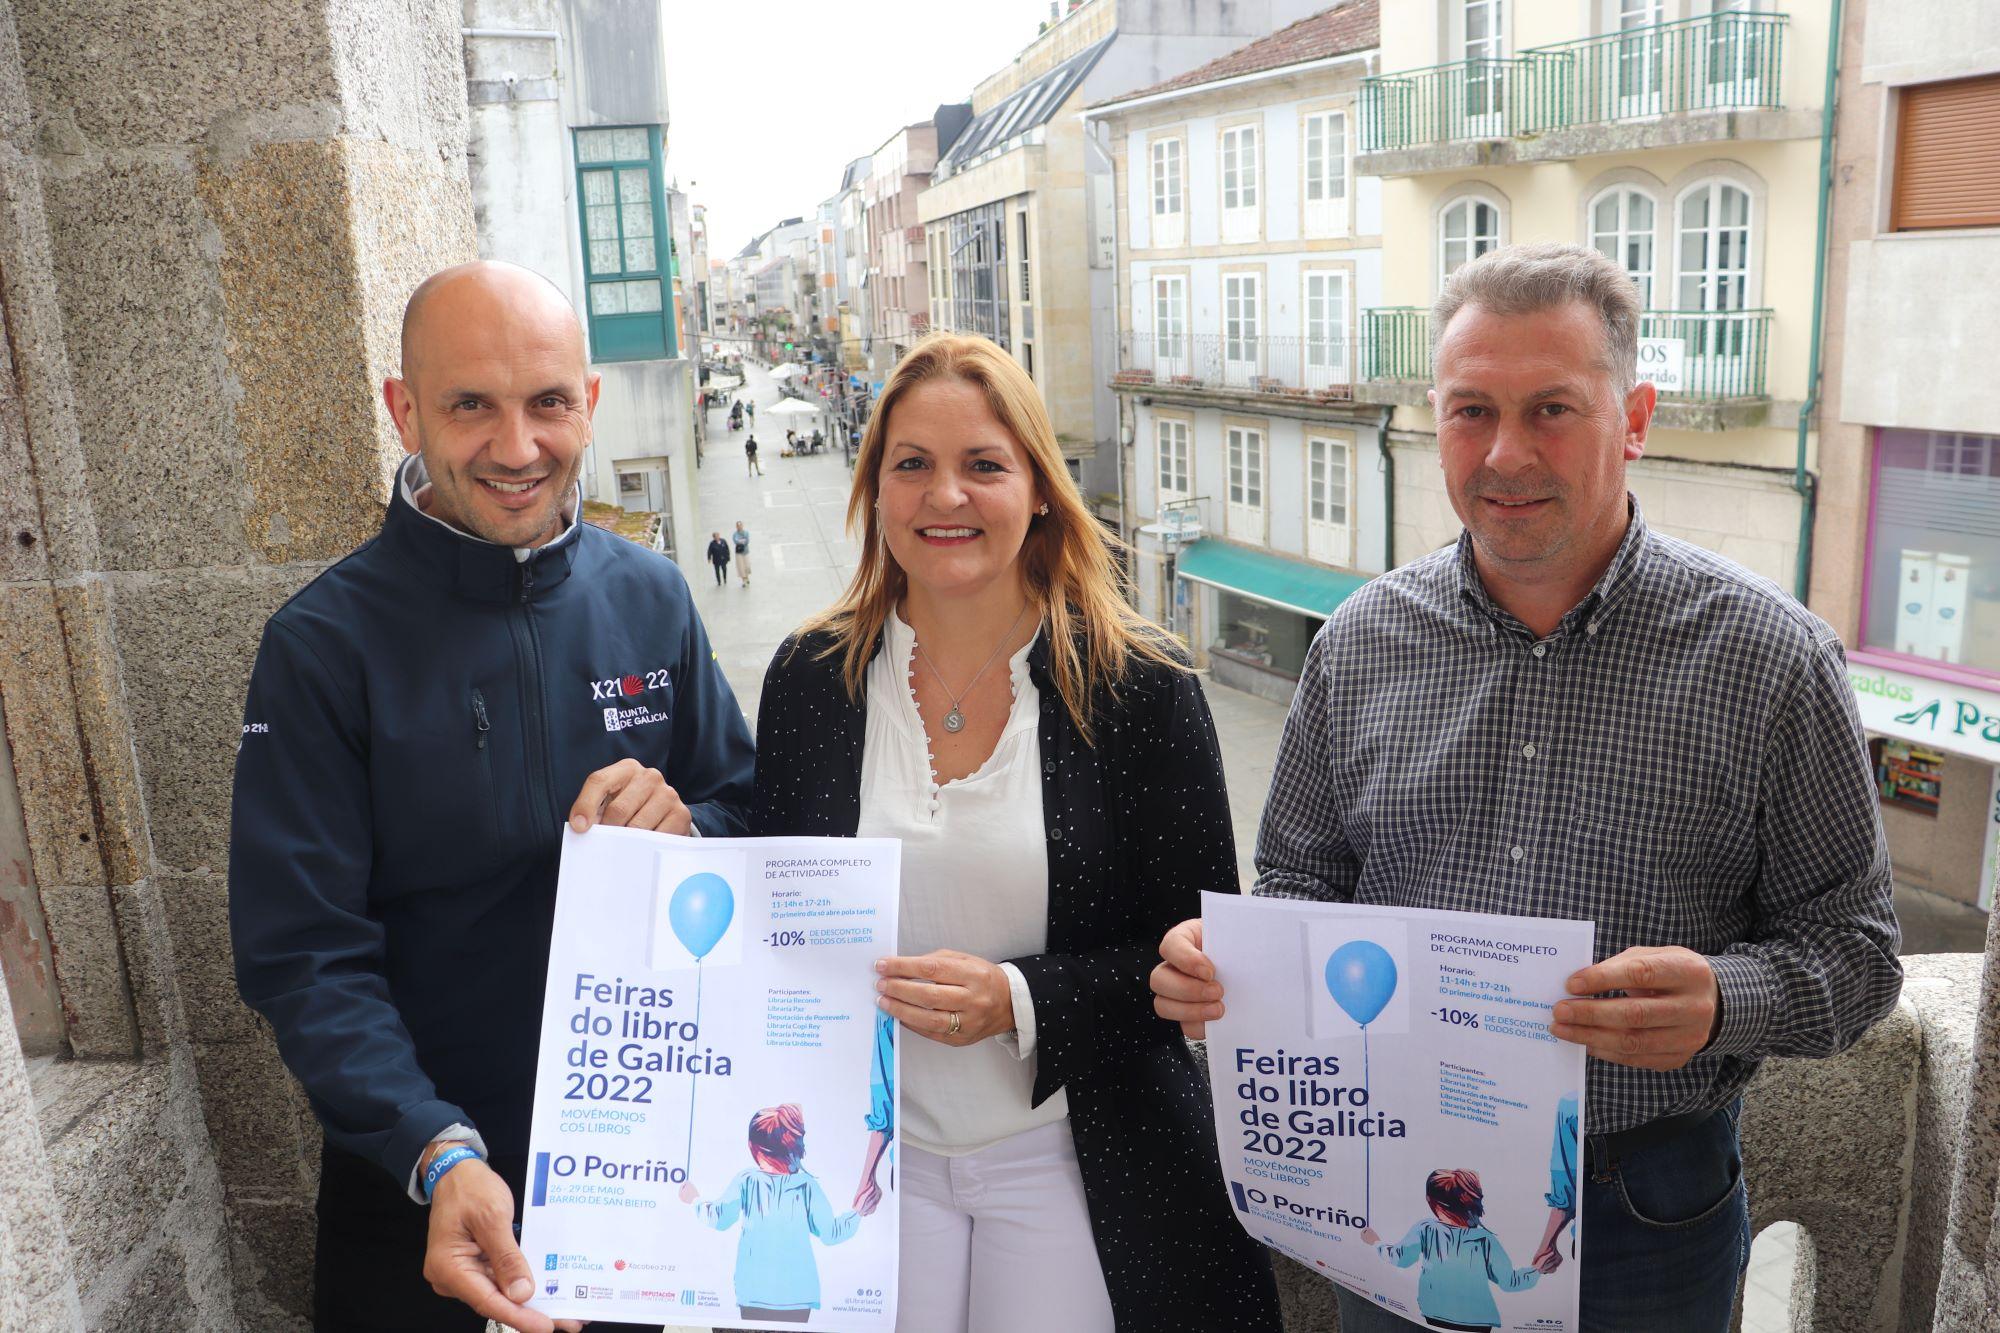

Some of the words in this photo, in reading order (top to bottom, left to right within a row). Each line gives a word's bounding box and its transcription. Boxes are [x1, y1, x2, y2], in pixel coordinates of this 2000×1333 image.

[1637, 345, 1667, 363] OS
[1637, 368, 1677, 384] orido
[590, 677, 623, 700] X21
[645, 669, 669, 690] 22
[619, 706, 649, 719] XUNTA
[620, 720, 633, 729] DE
[634, 712, 668, 725] GALICIA
[948, 715, 959, 728] S
[765, 859, 818, 868] PROGRAMA
[820, 858, 872, 867] COMPLETO
[765, 871, 777, 879] DE
[779, 869, 839, 879] ACTIVIDADES
[772, 890, 802, 898] Horario:
[772, 900, 798, 908] 11-14h
[805, 899, 831, 907] 17-21h
[771, 911, 779, 919] (O
[780, 910, 806, 919] primeiro
[842, 908, 855, 917] pola
[856, 908, 876, 916] tarde)
[763, 931, 806, 947] -10%
[820, 928, 861, 936] DESCONTO
[847, 936, 873, 944] LIBROS
[1430, 933, 1494, 949] PROGRAMA
[1495, 941, 1558, 956] COMPLETO
[1430, 943, 1445, 953] DE
[1447, 945, 1519, 963] ACTIVIDADES
[1440, 964, 1476, 977] Horario:
[574, 973, 674, 1008] Feiras
[1440, 975, 1470, 987] 11-14h
[1479, 980, 1511, 993] 17-21h
[1439, 986, 1448, 994] (O
[1449, 987, 1481, 1000] primeiro
[1504, 996, 1521, 1006] abre
[1522, 999, 1539, 1009] pola
[570, 1006, 613, 1037] do
[622, 1010, 699, 1042] libro
[1431, 1007, 1479, 1029] -10%
[1484, 1014, 1496, 1024] DE
[1497, 1016, 1546, 1031] DESCONTO
[1484, 1023, 1514, 1035] TODOS
[1515, 1028, 1527, 1037] OS
[1527, 1031, 1558, 1043] LIBROS
[567, 1039, 609, 1069] de
[617, 1043, 732, 1076] Galicia
[1235, 1048, 1340, 1076] Feiras
[1440, 1061, 1486, 1076] Participantes:
[563, 1072, 653, 1103] 2022
[1237, 1078, 1280, 1103] do
[1289, 1080, 1369, 1107] libro
[1488, 1095, 1528, 1110] Pontevedra
[560, 1108, 646, 1123] MOVÉMONOS
[1240, 1104, 1280, 1130] de
[1288, 1110, 1406, 1138] Galicia
[559, 1122, 585, 1133] COS
[588, 1123, 631, 1135] LIBROS
[1242, 1129, 1328, 1164] 2022
[428, 1171, 436, 1182] O
[553, 1155, 577, 1177] O
[584, 1155, 686, 1184] Porriño
[1244, 1157, 1323, 1179] MOVÉMONOS
[1245, 1167, 1268, 1178] COS
[1270, 1172, 1311, 1187] LIBROS
[550, 1184, 562, 1193] 26
[569, 1184, 581, 1193] 29
[582, 1185, 596, 1194] DE
[597, 1186, 625, 1195] MAIO
[550, 1195, 590, 1205] BARRIO
[591, 1196, 603, 1205] DE
[603, 1197, 623, 1206] SAN
[625, 1199, 657, 1209] BIEITO
[1247, 1188, 1268, 1204] O
[1273, 1194, 1367, 1229] Porriño
[1251, 1209, 1282, 1225] BARRIO
[1282, 1219, 1295, 1229] DE
[1294, 1223, 1313, 1235] SAN
[1314, 1230, 1342, 1243] BIEITO
[1265, 1208, 1275, 1216] 29
[1275, 1211, 1288, 1221] DE
[1289, 1216, 1312, 1228] MAIO
[570, 1263, 604, 1271] GALICIA
